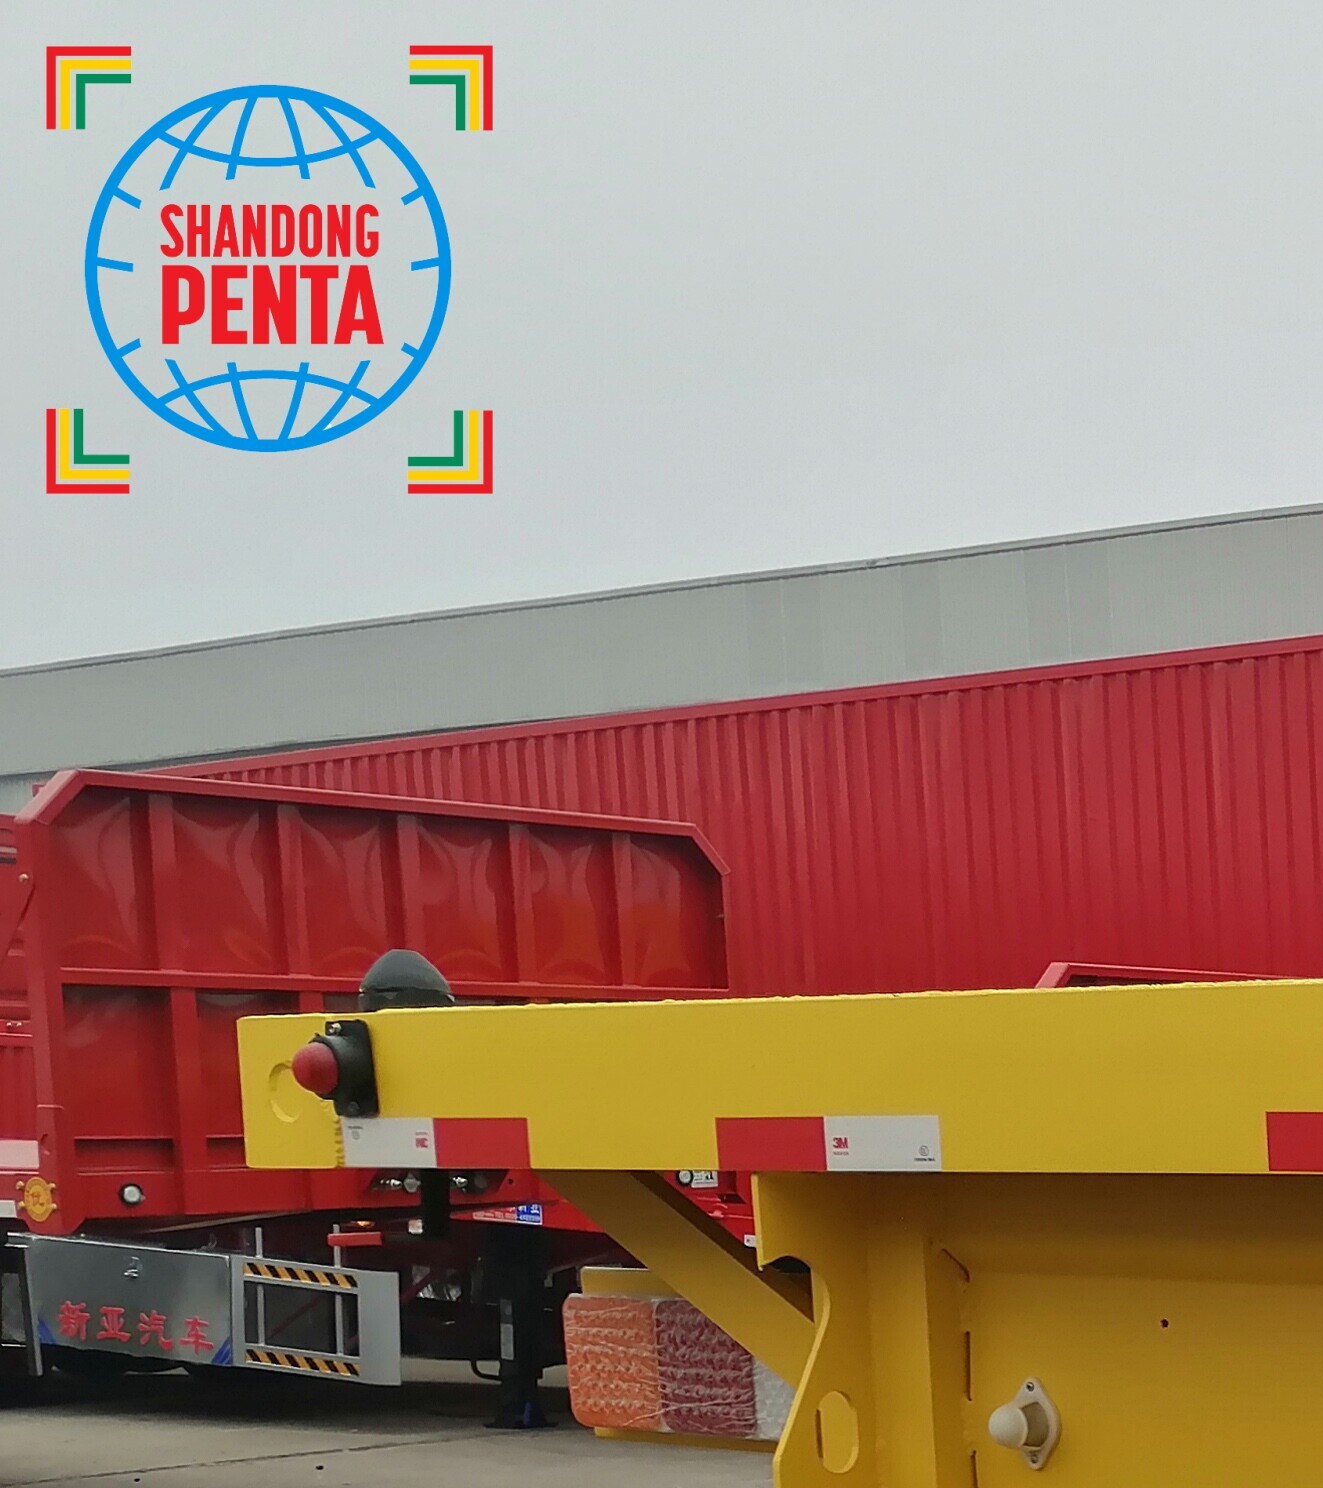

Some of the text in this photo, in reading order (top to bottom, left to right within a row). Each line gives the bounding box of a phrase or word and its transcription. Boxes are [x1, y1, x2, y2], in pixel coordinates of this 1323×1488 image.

[832, 1137, 849, 1149] 3M
[56, 1300, 214, 1354] 新亚汽车
